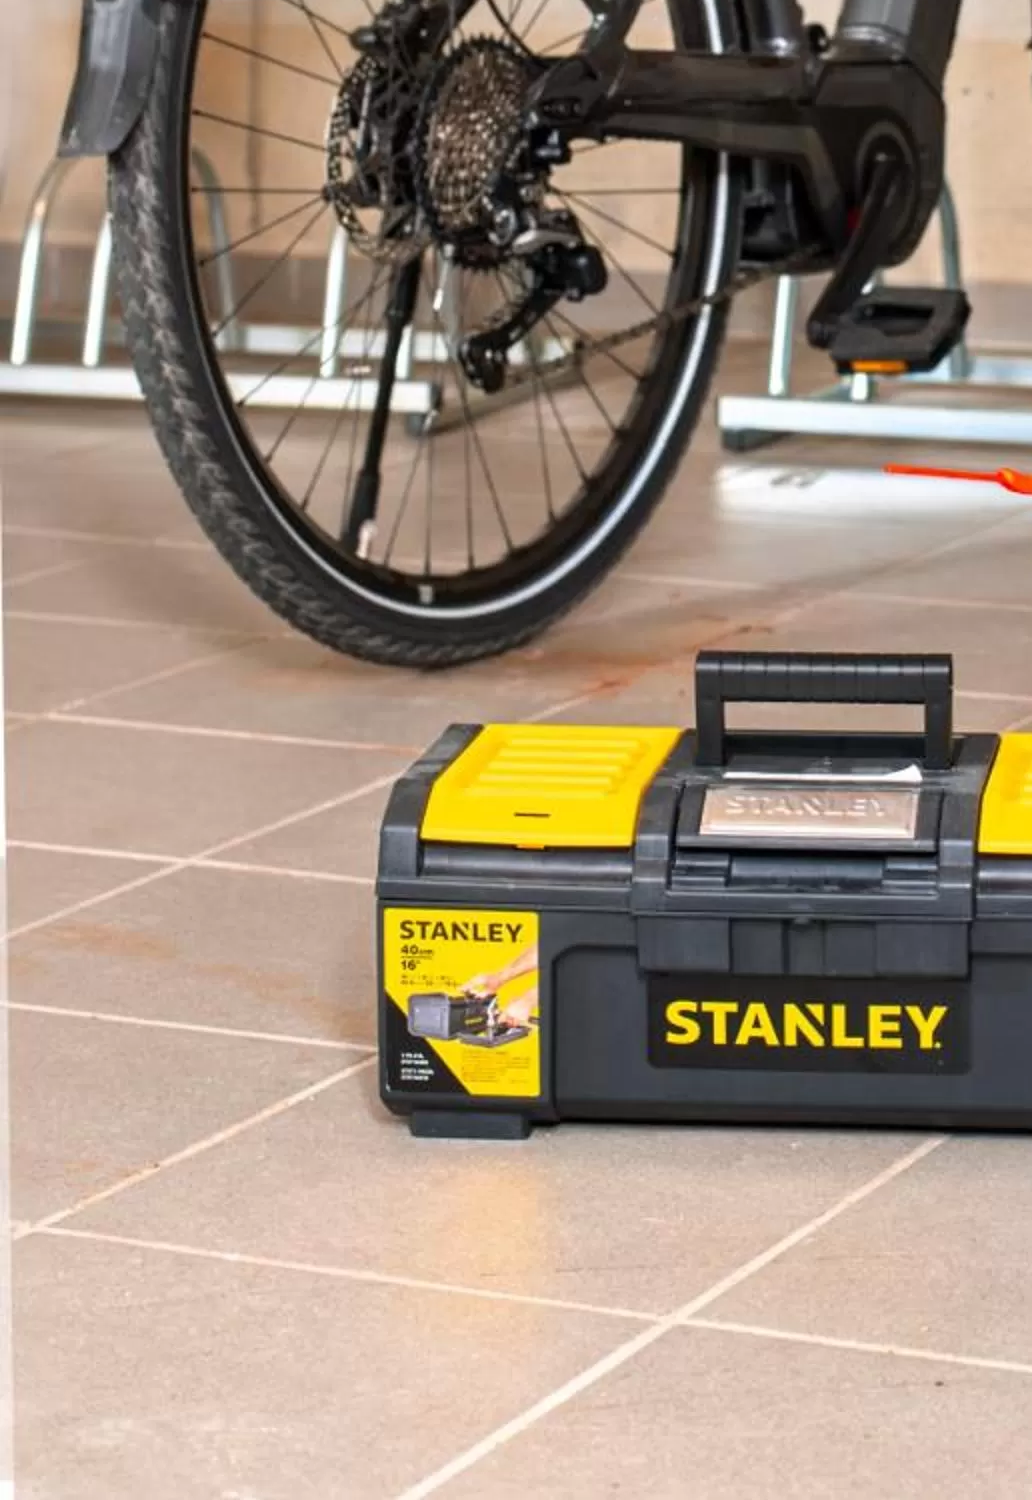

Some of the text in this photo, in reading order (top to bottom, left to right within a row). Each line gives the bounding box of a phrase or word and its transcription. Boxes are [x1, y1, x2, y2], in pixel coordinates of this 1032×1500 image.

[725, 795, 891, 817] STANLEY
[400, 920, 523, 943] STANLEY
[665, 1000, 948, 1049] STANLEY
